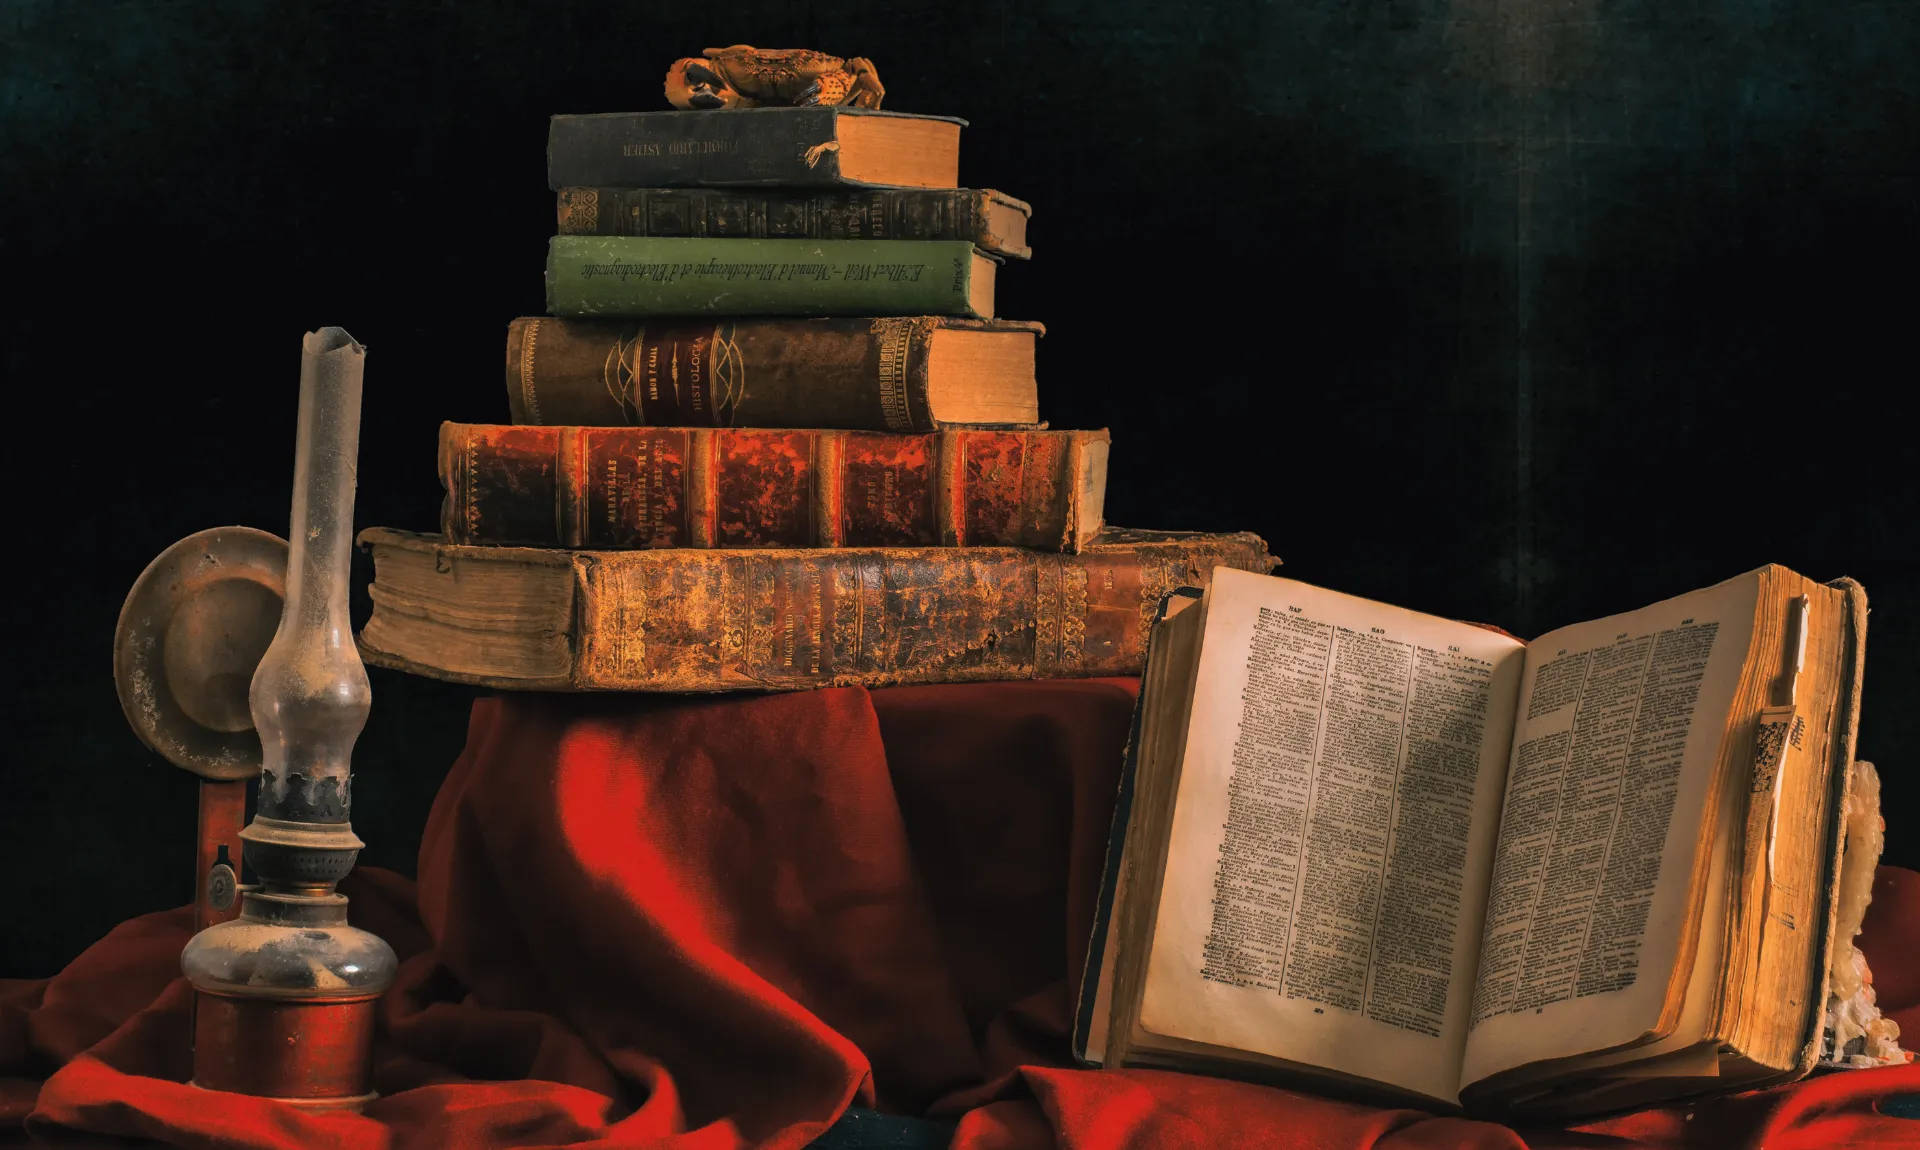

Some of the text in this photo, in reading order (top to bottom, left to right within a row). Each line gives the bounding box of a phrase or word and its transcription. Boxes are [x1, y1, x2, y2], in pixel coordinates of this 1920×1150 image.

[622, 143, 662, 157] ASTIER
[680, 264, 694, 281] et
[789, 263, 837, 281] Manuel
[648, 346, 659, 368] CAJAL
[648, 377, 659, 401] RAMON
[606, 459, 618, 523] MARAVILLAS
